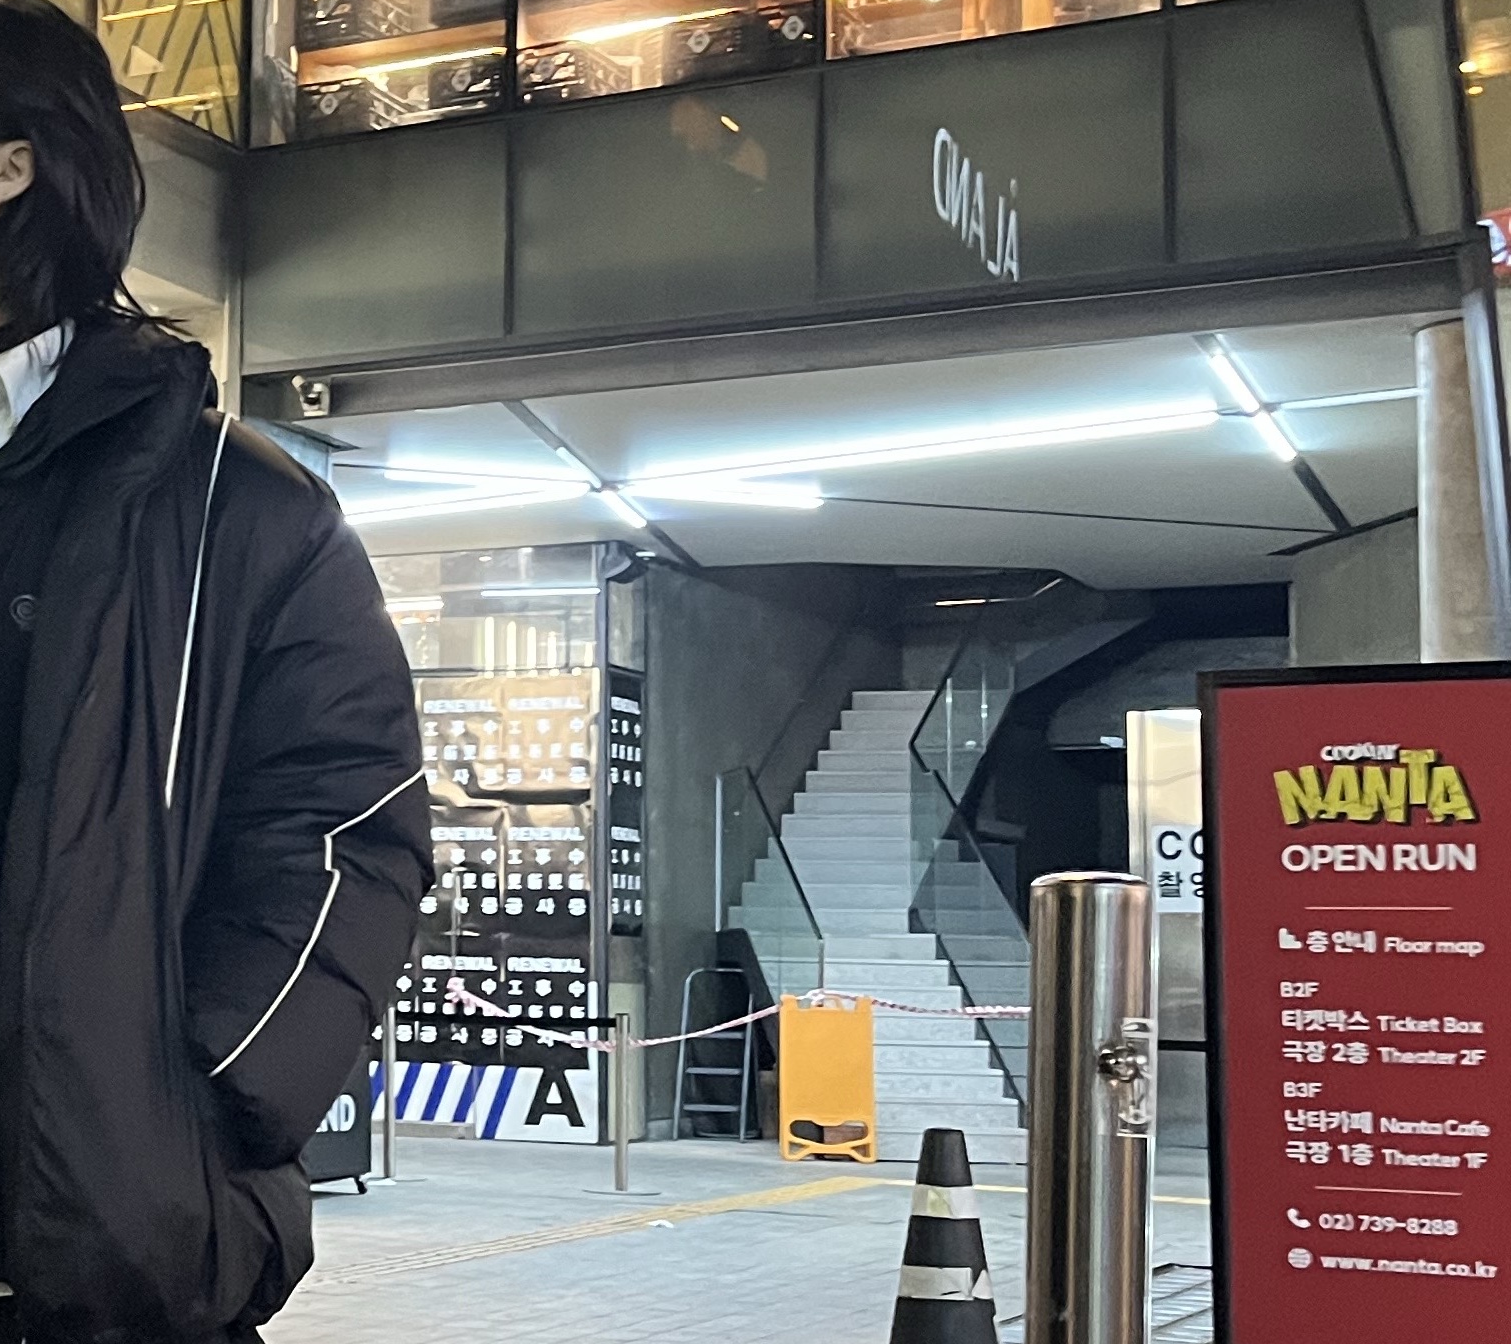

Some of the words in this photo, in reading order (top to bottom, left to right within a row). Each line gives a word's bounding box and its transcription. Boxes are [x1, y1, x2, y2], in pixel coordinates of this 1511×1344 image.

[1273, 748, 1478, 826] NANTA
[1281, 844, 1386, 872] OPEN
[1393, 843, 1477, 872] RUN
[1306, 930, 1330, 953] 층
[1331, 930, 1377, 954] 안내
[1384, 936, 1433, 954] Floor
[1435, 940, 1485, 957] map
[1280, 981, 1320, 998] B2F
[1281, 1009, 1371, 1032] 티켓박스
[1376, 1015, 1440, 1032] Ticket
[1443, 1016, 1484, 1034] Box
[1282, 1040, 1327, 1064] 극장
[1331, 1041, 1371, 1065] 2층
[1376, 1046, 1458, 1065] Theater
[1459, 1049, 1487, 1066] 2F
[1283, 1081, 1323, 1098] B3F
[1284, 1109, 1374, 1134] 난타카페
[1380, 1117, 1443, 1136] Nanta
[1444, 1119, 1491, 1137] Cafe
[1285, 1140, 1333, 1164] 극장
[1337, 1143, 1375, 1167] 1층
[1381, 1148, 1461, 1168] Theater
[1462, 1152, 1488, 1169] 1F
[1319, 1213, 1354, 1231] 02)
[1319, 1255, 1498, 1278] www.nanta.co.kr
